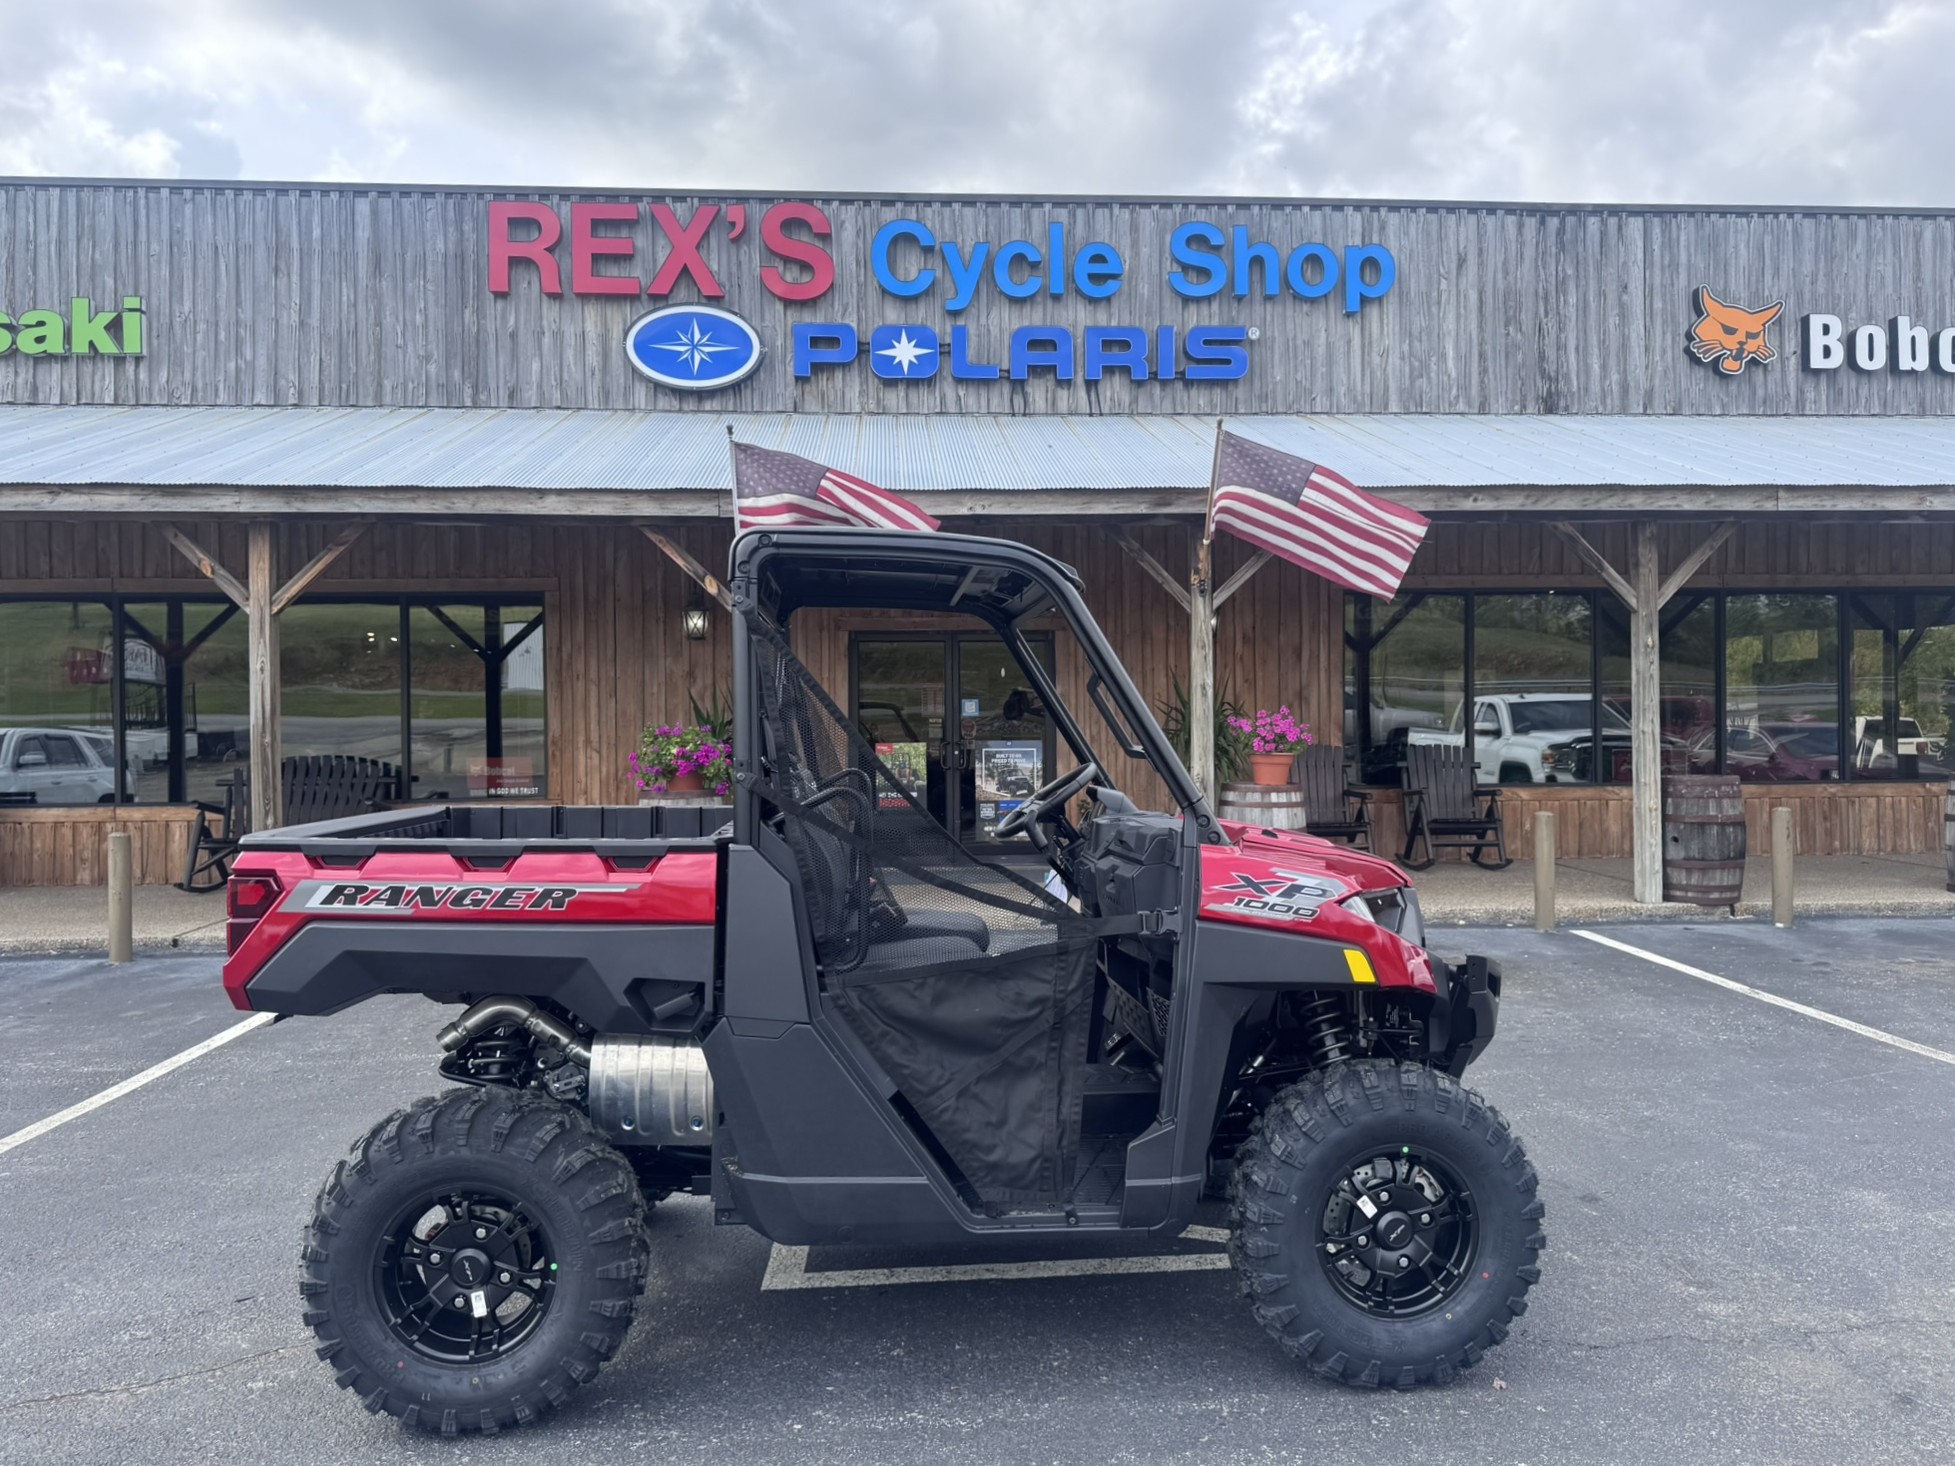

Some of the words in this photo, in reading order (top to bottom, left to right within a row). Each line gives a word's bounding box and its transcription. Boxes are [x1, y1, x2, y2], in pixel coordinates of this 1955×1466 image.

[488, 200, 835, 300] REX'S
[870, 218, 1125, 312] Cycle
[1168, 220, 1397, 315] Shop
[0, 296, 144, 357] aki
[793, 321, 1250, 381] POLARIS
[317, 884, 578, 911] RANGER
[1210, 872, 1338, 900] XP
[1233, 896, 1320, 919] 1000
